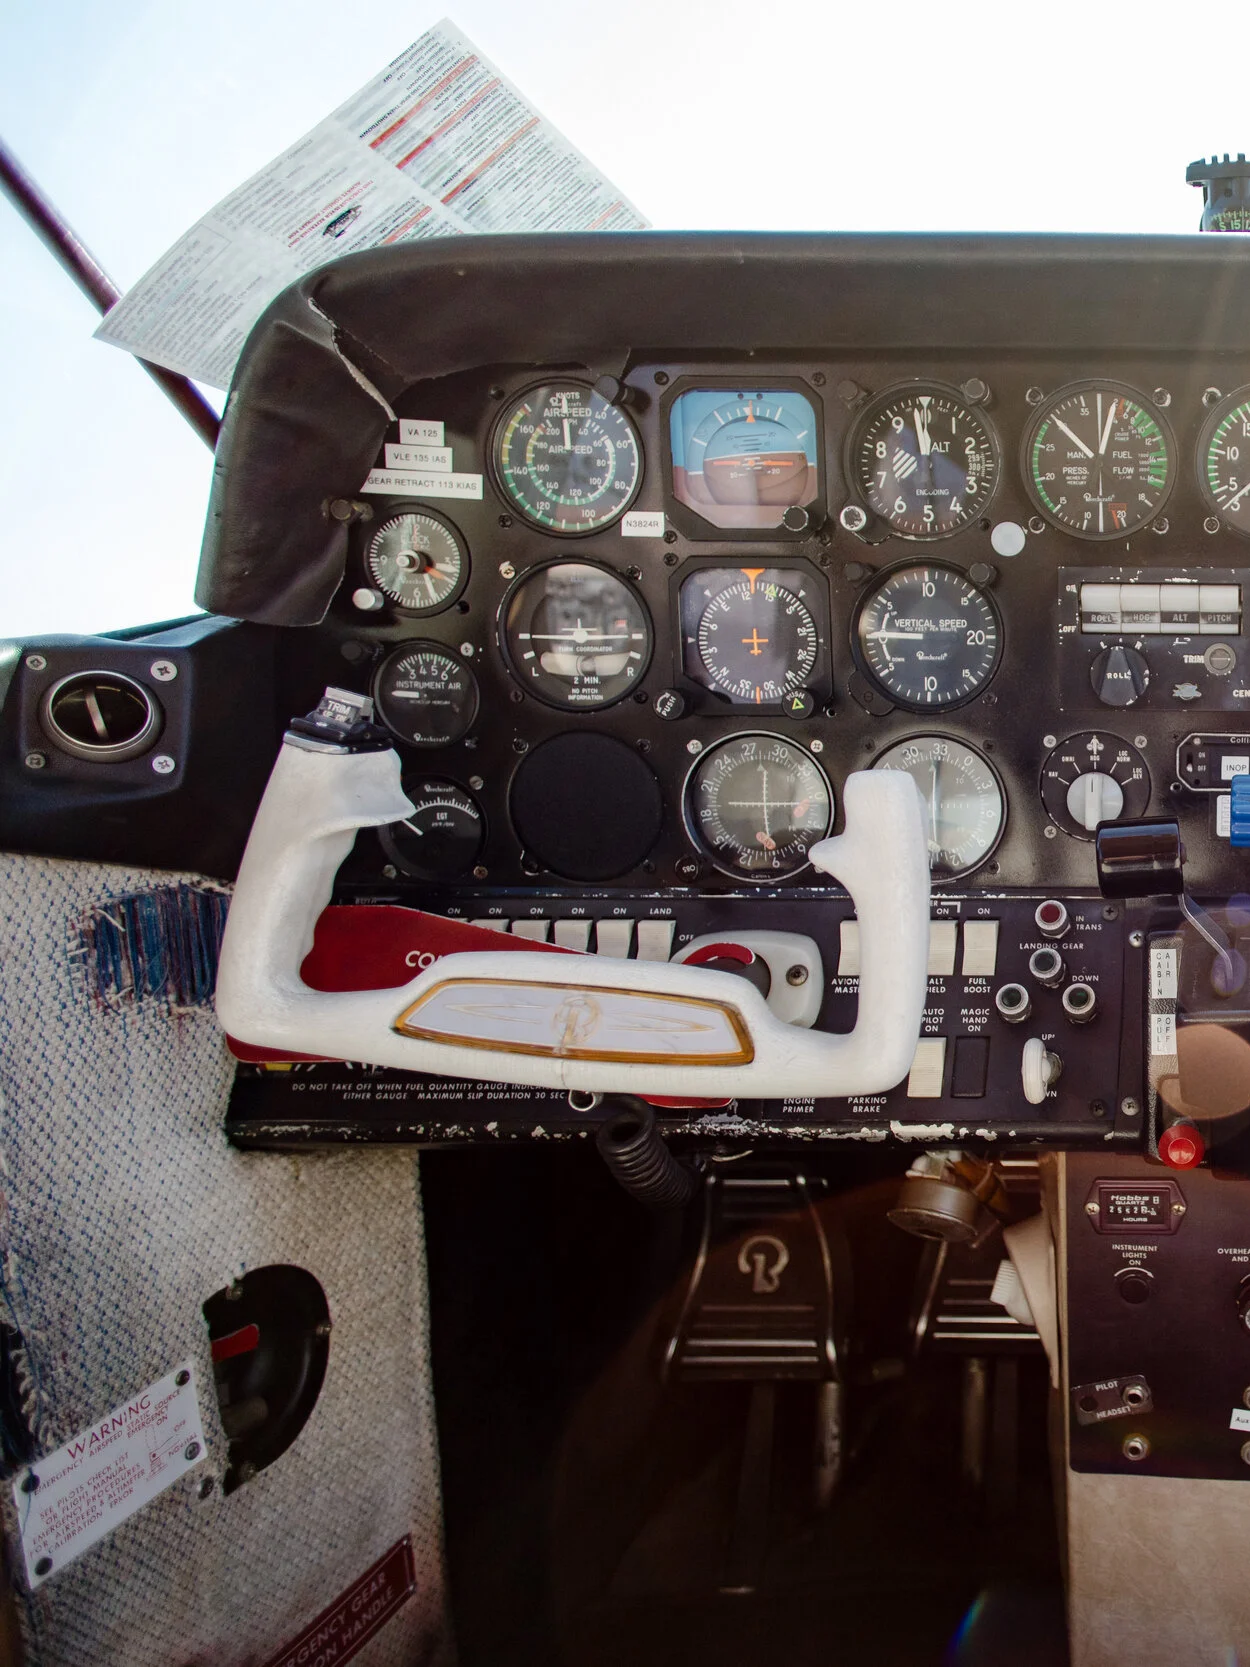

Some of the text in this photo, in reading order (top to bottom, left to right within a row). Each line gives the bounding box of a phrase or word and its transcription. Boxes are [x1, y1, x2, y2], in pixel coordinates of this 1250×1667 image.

[423, 429, 438, 438] 125
[393, 453, 447, 463] VLE 135 IAS
[1112, 451, 1133, 459] FUEL
[1062, 467, 1090, 475] PRESS.
[1112, 466, 1134, 475] FLOW
[367, 476, 477, 491] GEAR RETRACT 113 KIAS
[626, 520, 659, 528] N3824R
[894, 618, 968, 628] VERTICAL SPEED
[966, 630, 986, 646] 20
[396, 681, 462, 691] INSTRUMENT AIR
[327, 700, 352, 715] TRIM
[741, 743, 756, 756] 27
[1225, 764, 1247, 772] INOP
[571, 907, 585, 915] ON
[613, 907, 627, 915] ON
[649, 907, 672, 915] LAND
[936, 907, 950, 915] ON
[977, 907, 991, 915] ON
[1076, 923, 1102, 931] TRANS
[968, 977, 987, 985] FUEL
[1072, 974, 1099, 982] DOWN
[963, 985, 991, 994] BOOST
[960, 1008, 990, 1016] MAGIC
[962, 1016, 988, 1024] HAND
[924, 1025, 939, 1033] ON
[331, 1083, 352, 1091] TAKE
[356, 1083, 372, 1091] OFF
[376, 1083, 401, 1091] WHEN
[406, 1083, 424, 1091] FUEL
[429, 1083, 472, 1091] QUANTITY
[476, 1083, 508, 1091] GAUGE
[343, 1092, 565, 1100] EITHER GAUGE MAXIMUM SLIP DURATION 30 SEC
[847, 1097, 887, 1105] PARKING
[782, 1105, 815, 1113] PRIMER
[852, 1105, 881, 1113] BRAKE
[1111, 1244, 1158, 1252] INSTRUMENT
[1231, 1255, 1249, 1263] AND
[1096, 1405, 1131, 1419] HEADSET
[1235, 1415, 1250, 1425] Aux
[67, 1396, 151, 1459] WARNING
[349, 1572, 387, 1613] GEAR
[341, 1586, 395, 1645] HANDLE
